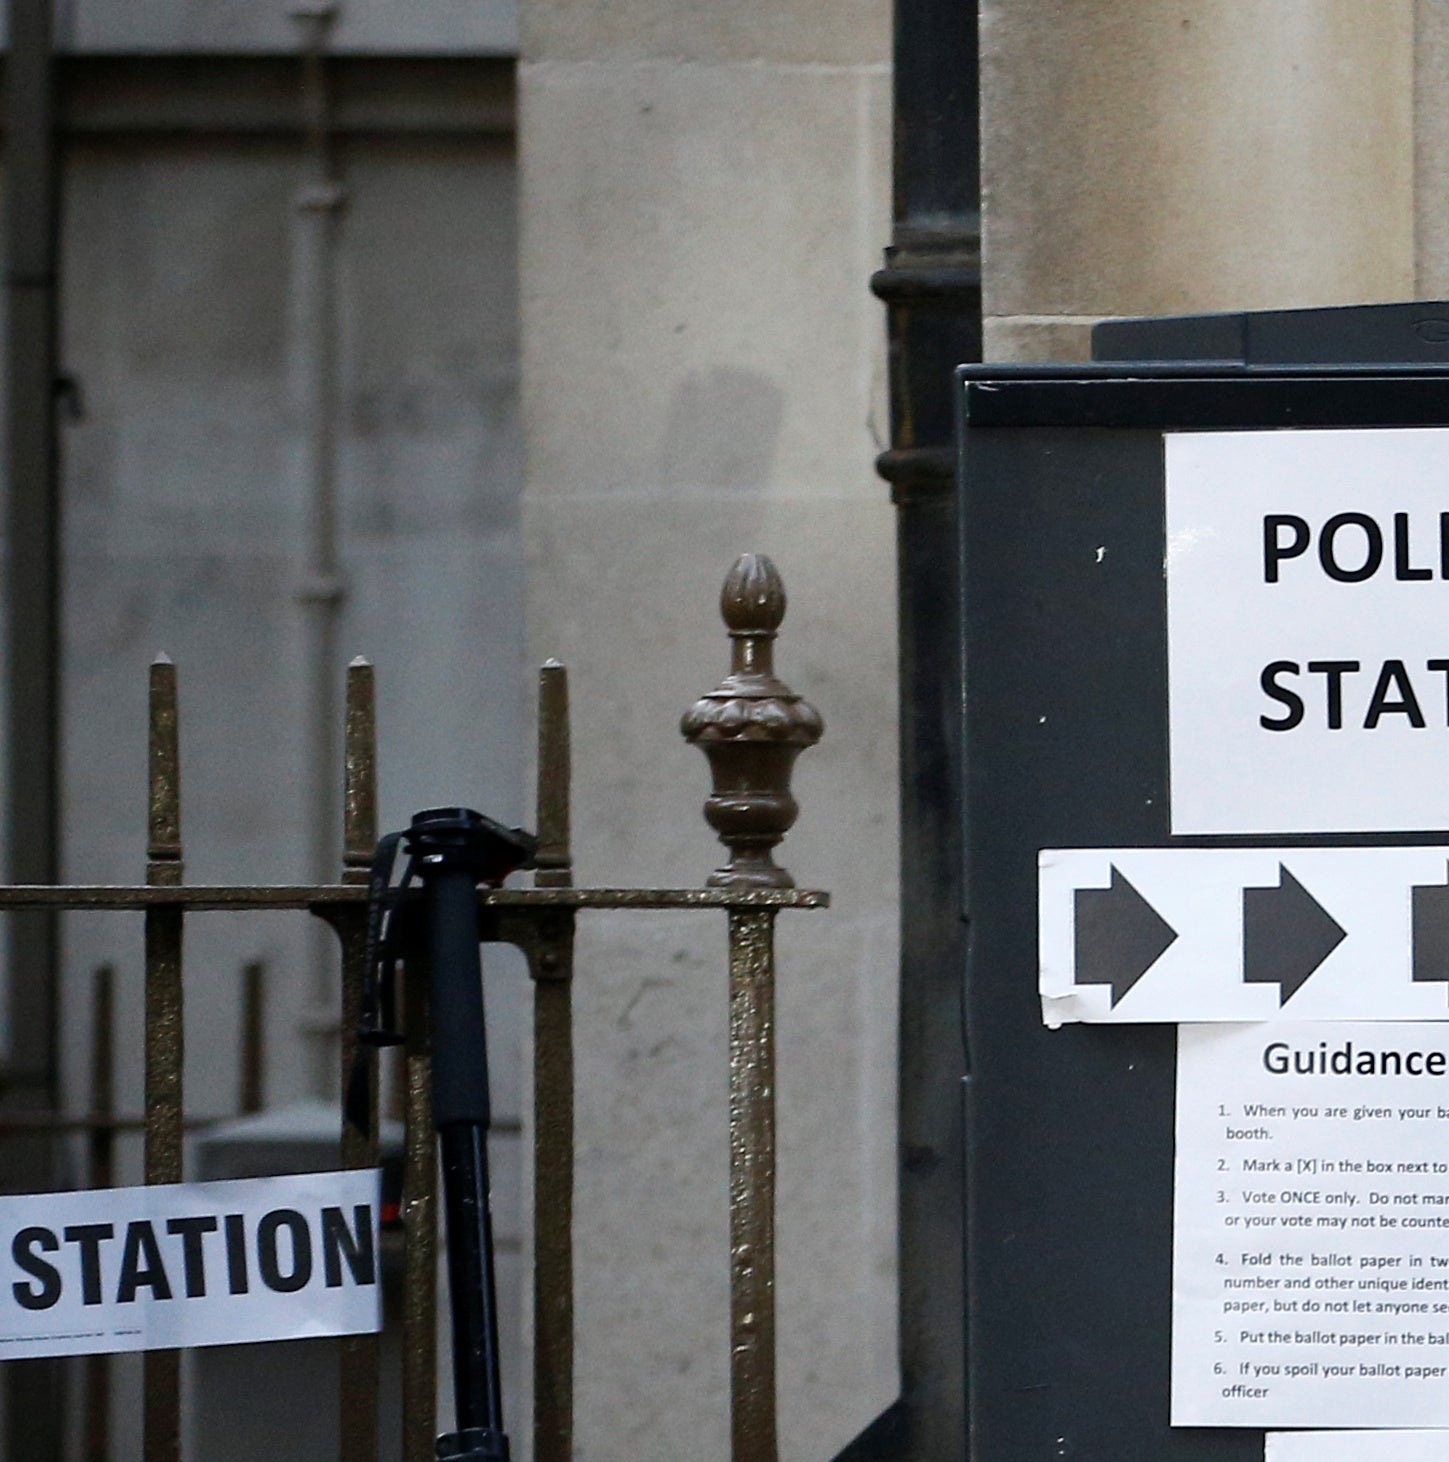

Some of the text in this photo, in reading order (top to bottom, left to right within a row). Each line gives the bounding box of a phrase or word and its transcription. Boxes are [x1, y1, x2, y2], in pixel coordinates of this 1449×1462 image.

[1263, 1041, 1446, 1077] Guidance
[1218, 1104, 1230, 1117] 1.
[1243, 1103, 1286, 1117] When
[1291, 1107, 1318, 1121] you
[1324, 1107, 1348, 1118] are
[1352, 1104, 1392, 1121] given
[1397, 1108, 1432, 1122] your
[1225, 1126, 1273, 1140] booth.
[1217, 1158, 1229, 1172] 2.
[1242, 1158, 1280, 1172] Mark
[1284, 1161, 1293, 1172] a
[1297, 1158, 1317, 1175] [X]
[1321, 1159, 1334, 1172] in
[1338, 1158, 1363, 1173] the
[1366, 1159, 1393, 1173] box
[1396, 1161, 1429, 1174] next
[1432, 1161, 1448, 1174] to
[1217, 1190, 1229, 1204] 3.
[1242, 1190, 1276, 1204] Vote
[1280, 1190, 1320, 1204] ONCE
[1324, 1191, 1360, 1208] only.
[1369, 1191, 1389, 1205] Do
[1393, 1193, 1418, 1205] not
[1224, 1216, 1240, 1226] or
[1243, 1216, 1277, 1229] your
[1279, 1215, 1313, 1227] vote
[1316, 1216, 1347, 1230] may
[1350, 1215, 1375, 1228] not
[1379, 1214, 1397, 1228] be
[12, 1205, 376, 1310] STATION
[1214, 1252, 1228, 1266] 4.
[1241, 1252, 1272, 1266] Fold
[1278, 1252, 1303, 1266] the
[1310, 1252, 1352, 1267] ballot
[1359, 1256, 1402, 1270] paper
[1408, 1254, 1422, 1267] in
[1223, 1275, 1281, 1289] number
[1283, 1276, 1311, 1289] and
[1314, 1276, 1355, 1290] other
[1357, 1276, 1408, 1293] unique
[1223, 1301, 1269, 1314] paper,
[1273, 1298, 1298, 1313] but
[1301, 1298, 1320, 1313] do
[1324, 1300, 1349, 1313] not
[1352, 1299, 1372, 1313] let
[1374, 1302, 1429, 1316] anyone
[1214, 1330, 1227, 1343] 5.
[1240, 1330, 1264, 1344] Put
[1267, 1330, 1292, 1344] the
[1294, 1330, 1336, 1345] ballot
[1339, 1334, 1382, 1347] paper
[1384, 1331, 1397, 1345] in
[1400, 1331, 1425, 1346] the
[1213, 1361, 1226, 1375] 6.
[1239, 1361, 1250, 1375] If
[1253, 1364, 1280, 1378] you
[1283, 1362, 1318, 1379] spoil
[1321, 1365, 1355, 1379] your
[1358, 1362, 1401, 1377] ballot
[1404, 1366, 1447, 1380] paper
[1221, 1384, 1269, 1399] officer
